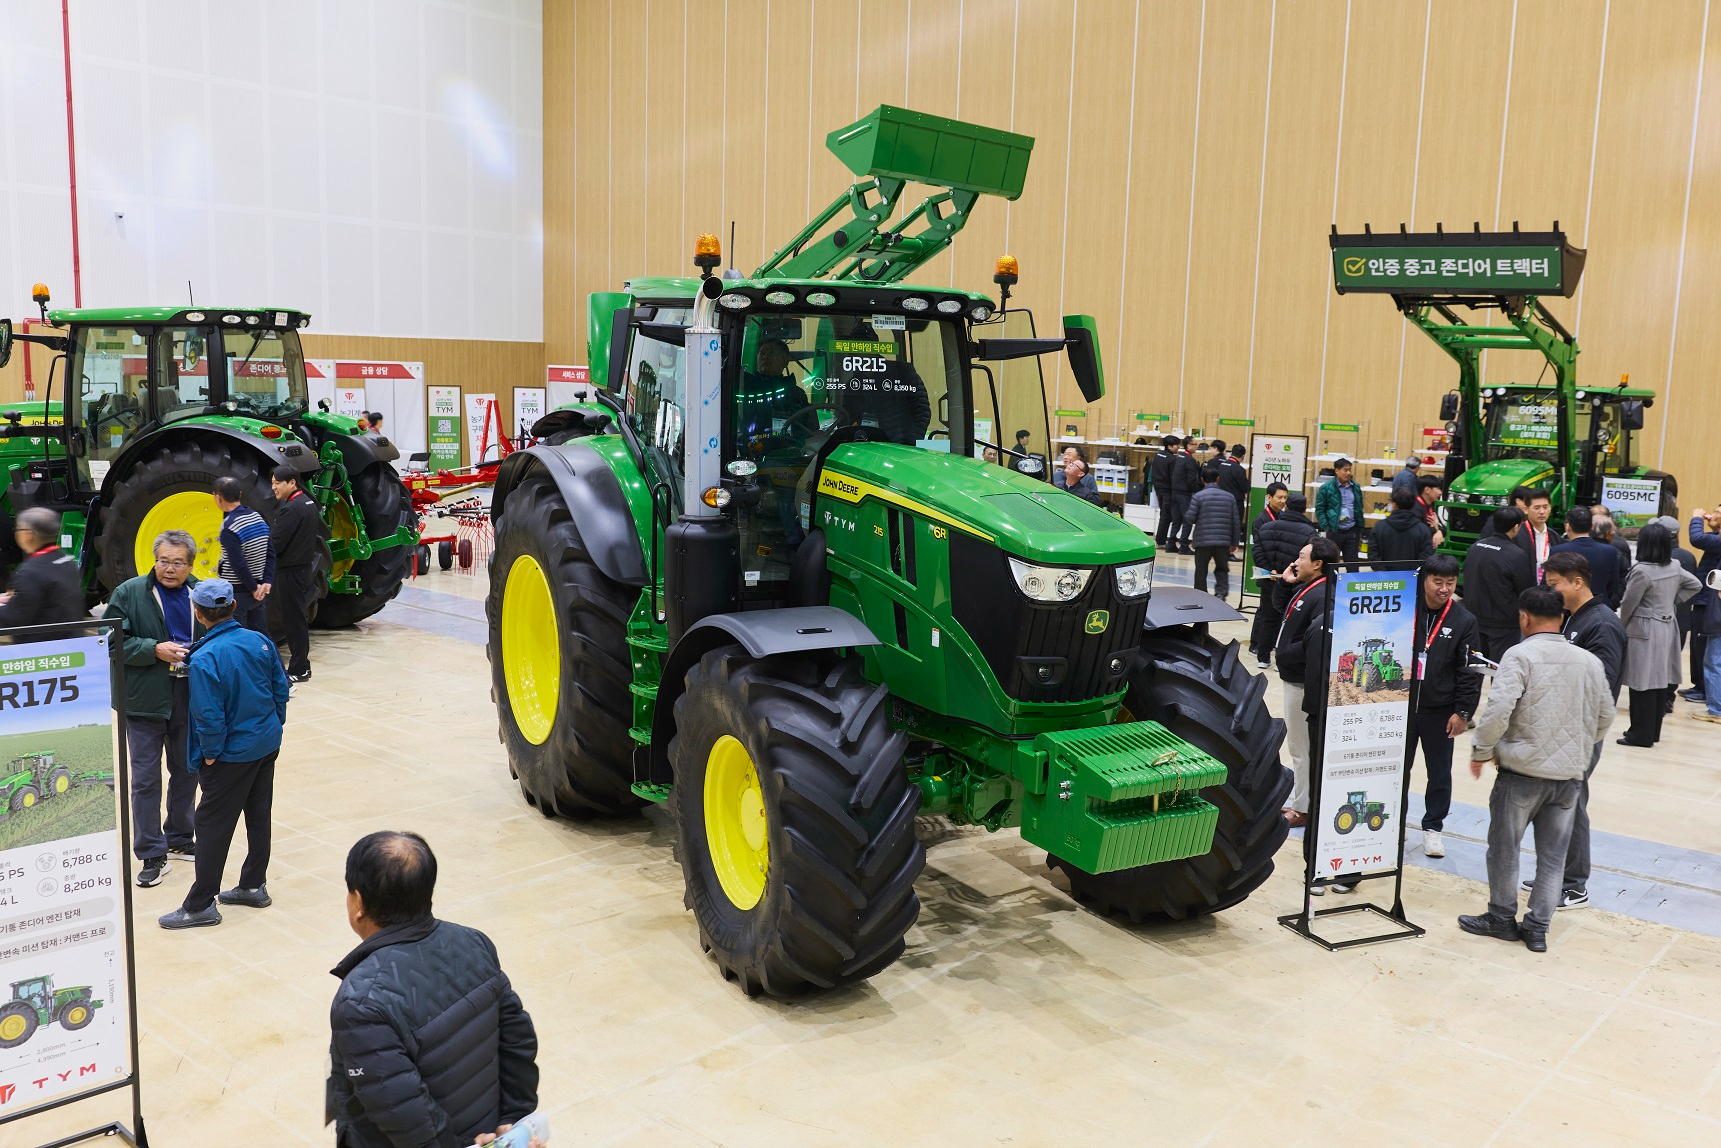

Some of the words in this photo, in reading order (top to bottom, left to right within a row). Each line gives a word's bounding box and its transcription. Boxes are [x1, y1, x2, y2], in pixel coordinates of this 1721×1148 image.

[1368, 257, 1400, 277] 인증
[1403, 257, 1437, 277] 중고
[1440, 257, 1491, 277] 존디어
[1495, 257, 1549, 277] 트랙터
[835, 342, 851, 352] 독일
[851, 342, 872, 353] 만하임
[873, 343, 893, 353] 직수입
[842, 356, 887, 372] 6R215
[361, 366, 374, 375] 금융
[375, 366, 389, 376] 상담
[562, 370, 575, 379] 서비스
[576, 370, 586, 380] 상담
[1519, 405, 1558, 415] 6095M
[1262, 471, 1291, 484] TYM
[822, 476, 838, 490] JOHN
[838, 480, 859, 496] DEERE
[1606, 490, 1656, 502] 6095MC
[833, 516, 856, 532] TYM
[873, 525, 884, 537] 215
[933, 526, 947, 539] 6R
[1354, 582, 1366, 591] 독일
[1383, 581, 1399, 590] 직수입
[1349, 595, 1402, 615] 6R215
[2, 659, 36, 674] 만하임
[38, 655, 70, 669] 직수입
[0, 675, 80, 711] R175
[1395, 730, 1403, 738] kg
[62, 854, 93, 869] 6,788
[95, 853, 107, 862] cc
[1350, 855, 1382, 866] TYM
[8, 867, 25, 879] PS
[64, 878, 95, 894] 8,260
[98, 876, 112, 888] kg
[11, 895, 18, 905] L
[18, 916, 44, 930] 존디어
[45, 912, 63, 924] 엔진
[64, 908, 81, 920] 탑재
[22, 942, 39, 953] 미션
[40, 938, 58, 949] 탑재
[63, 931, 89, 943] 커맨드
[89, 926, 107, 938] 프로
[32, 1062, 97, 1090] TYM
